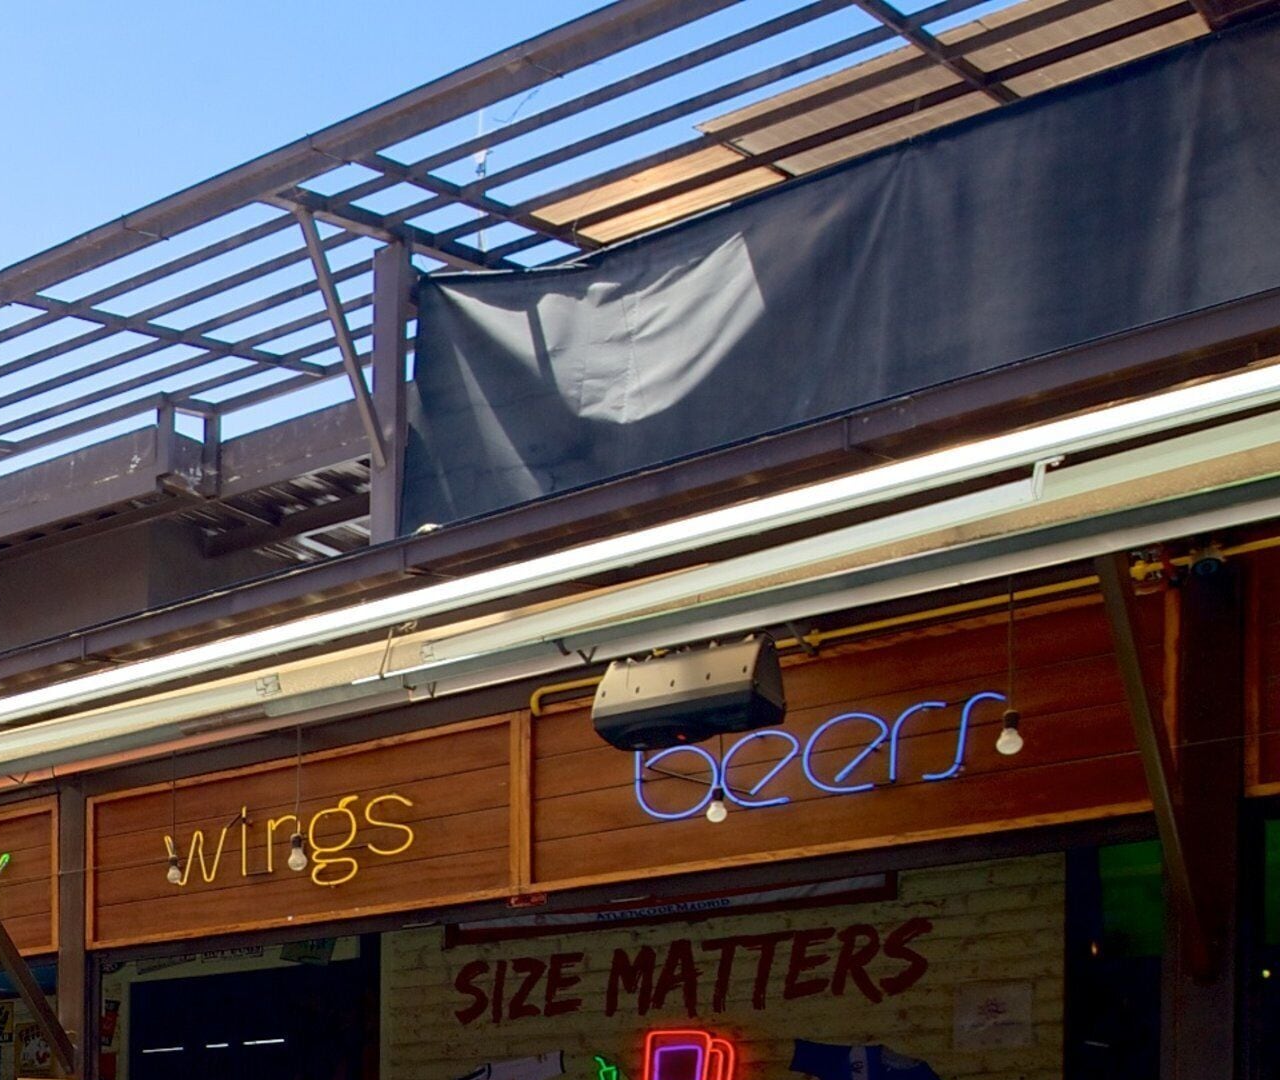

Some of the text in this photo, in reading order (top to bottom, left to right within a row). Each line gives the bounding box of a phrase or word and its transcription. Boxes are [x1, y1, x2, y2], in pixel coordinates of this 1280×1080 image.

[635, 692, 1006, 820] beers
[164, 795, 414, 886] wings
[676, 899, 731, 912] MADRID
[454, 917, 933, 1026] SIZE MATTERS
